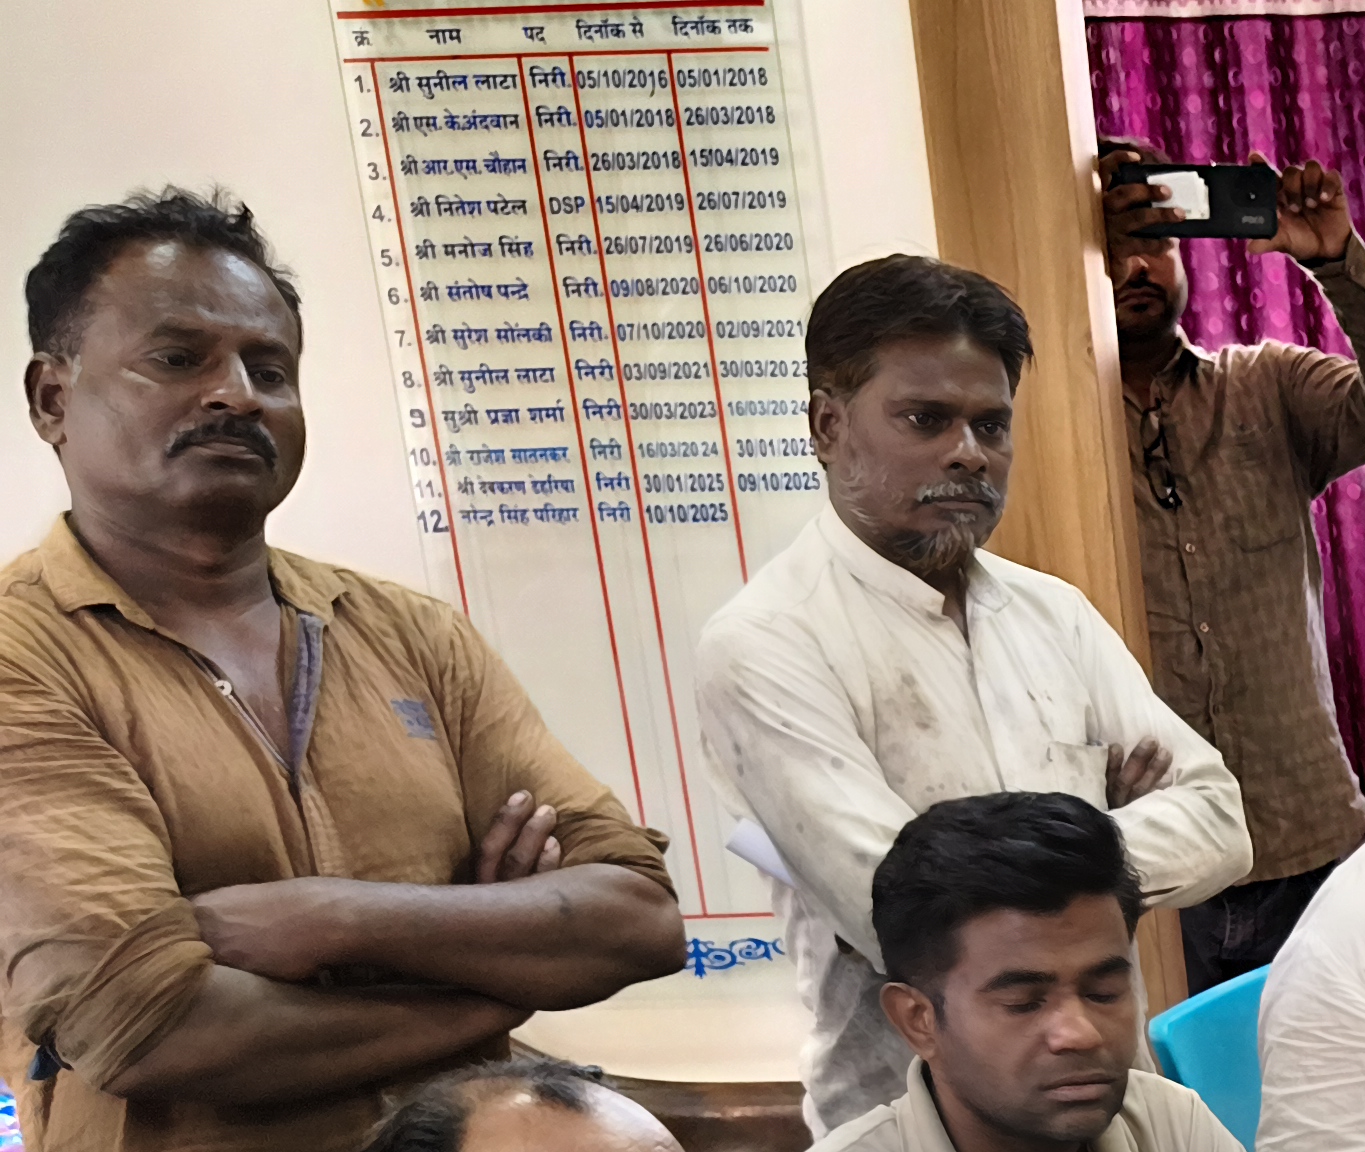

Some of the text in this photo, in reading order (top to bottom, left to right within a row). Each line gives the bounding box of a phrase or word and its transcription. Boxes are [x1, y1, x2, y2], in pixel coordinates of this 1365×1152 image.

[425, 28, 462, 45] नाम
[522, 26, 546, 42] पद
[628, 15, 645, 37] से
[725, 18, 754, 34] तक
[354, 74, 372, 94] 1.
[388, 71, 411, 93] श्री
[415, 69, 469, 100] सुनील
[472, 73, 518, 90] लाटा
[575, 69, 668, 98] 05/10/2016
[676, 67, 768, 89] 05/01/2018
[359, 118, 380, 138] 2.
[391, 110, 411, 133] श्री
[583, 108, 676, 129] 05/01/2018
[683, 105, 776, 127] 26/03/2018
[367, 161, 387, 181] 3.
[400, 154, 419, 176] श्री
[482, 150, 527, 175] चौहान
[590, 150, 683, 172] 26/03/2018
[688, 147, 780, 168] 15/04/2019
[371, 190, 787, 223] 4. श्री नितेश पटेल DSP 15/04/2019 26/07/2019
[380, 248, 400, 268] 5.
[415, 238, 437, 260] श्री
[442, 235, 494, 259] मनोज
[498, 234, 534, 258] सिंह
[603, 234, 694, 256] 26/07/2019
[703, 232, 794, 253] 26/06/2020
[387, 287, 409, 306] 6.
[419, 280, 440, 302] श्री
[445, 280, 493, 302] संतोष
[609, 276, 701, 298] 09/08/2020
[707, 274, 797, 295] 06/10/2020
[394, 329, 412, 348] 7.
[425, 323, 447, 345] श्री
[451, 326, 489, 350] सुरेश
[616, 320, 706, 343] 07/10/2020
[715, 319, 803, 340] 02/09/2021
[433, 364, 455, 387] श्री
[457, 366, 510, 394] सुनील
[513, 367, 556, 384] लाटा
[621, 361, 711, 382] 03/09/2021
[441, 402, 479, 434] सुश्री
[526, 398, 565, 424] शर्मा
[581, 397, 622, 420] निरी
[629, 400, 718, 421] 30/03/2023
[444, 443, 463, 467] श्री
[589, 437, 622, 460] निरी
[457, 475, 476, 496] श्री
[595, 471, 631, 491] निरी
[643, 472, 725, 494] 30/01/2025
[737, 471, 821, 493] 09/10/2025
[498, 503, 530, 524] सिंह
[597, 500, 631, 523] निरी
[645, 502, 729, 524] 10/10/2025
